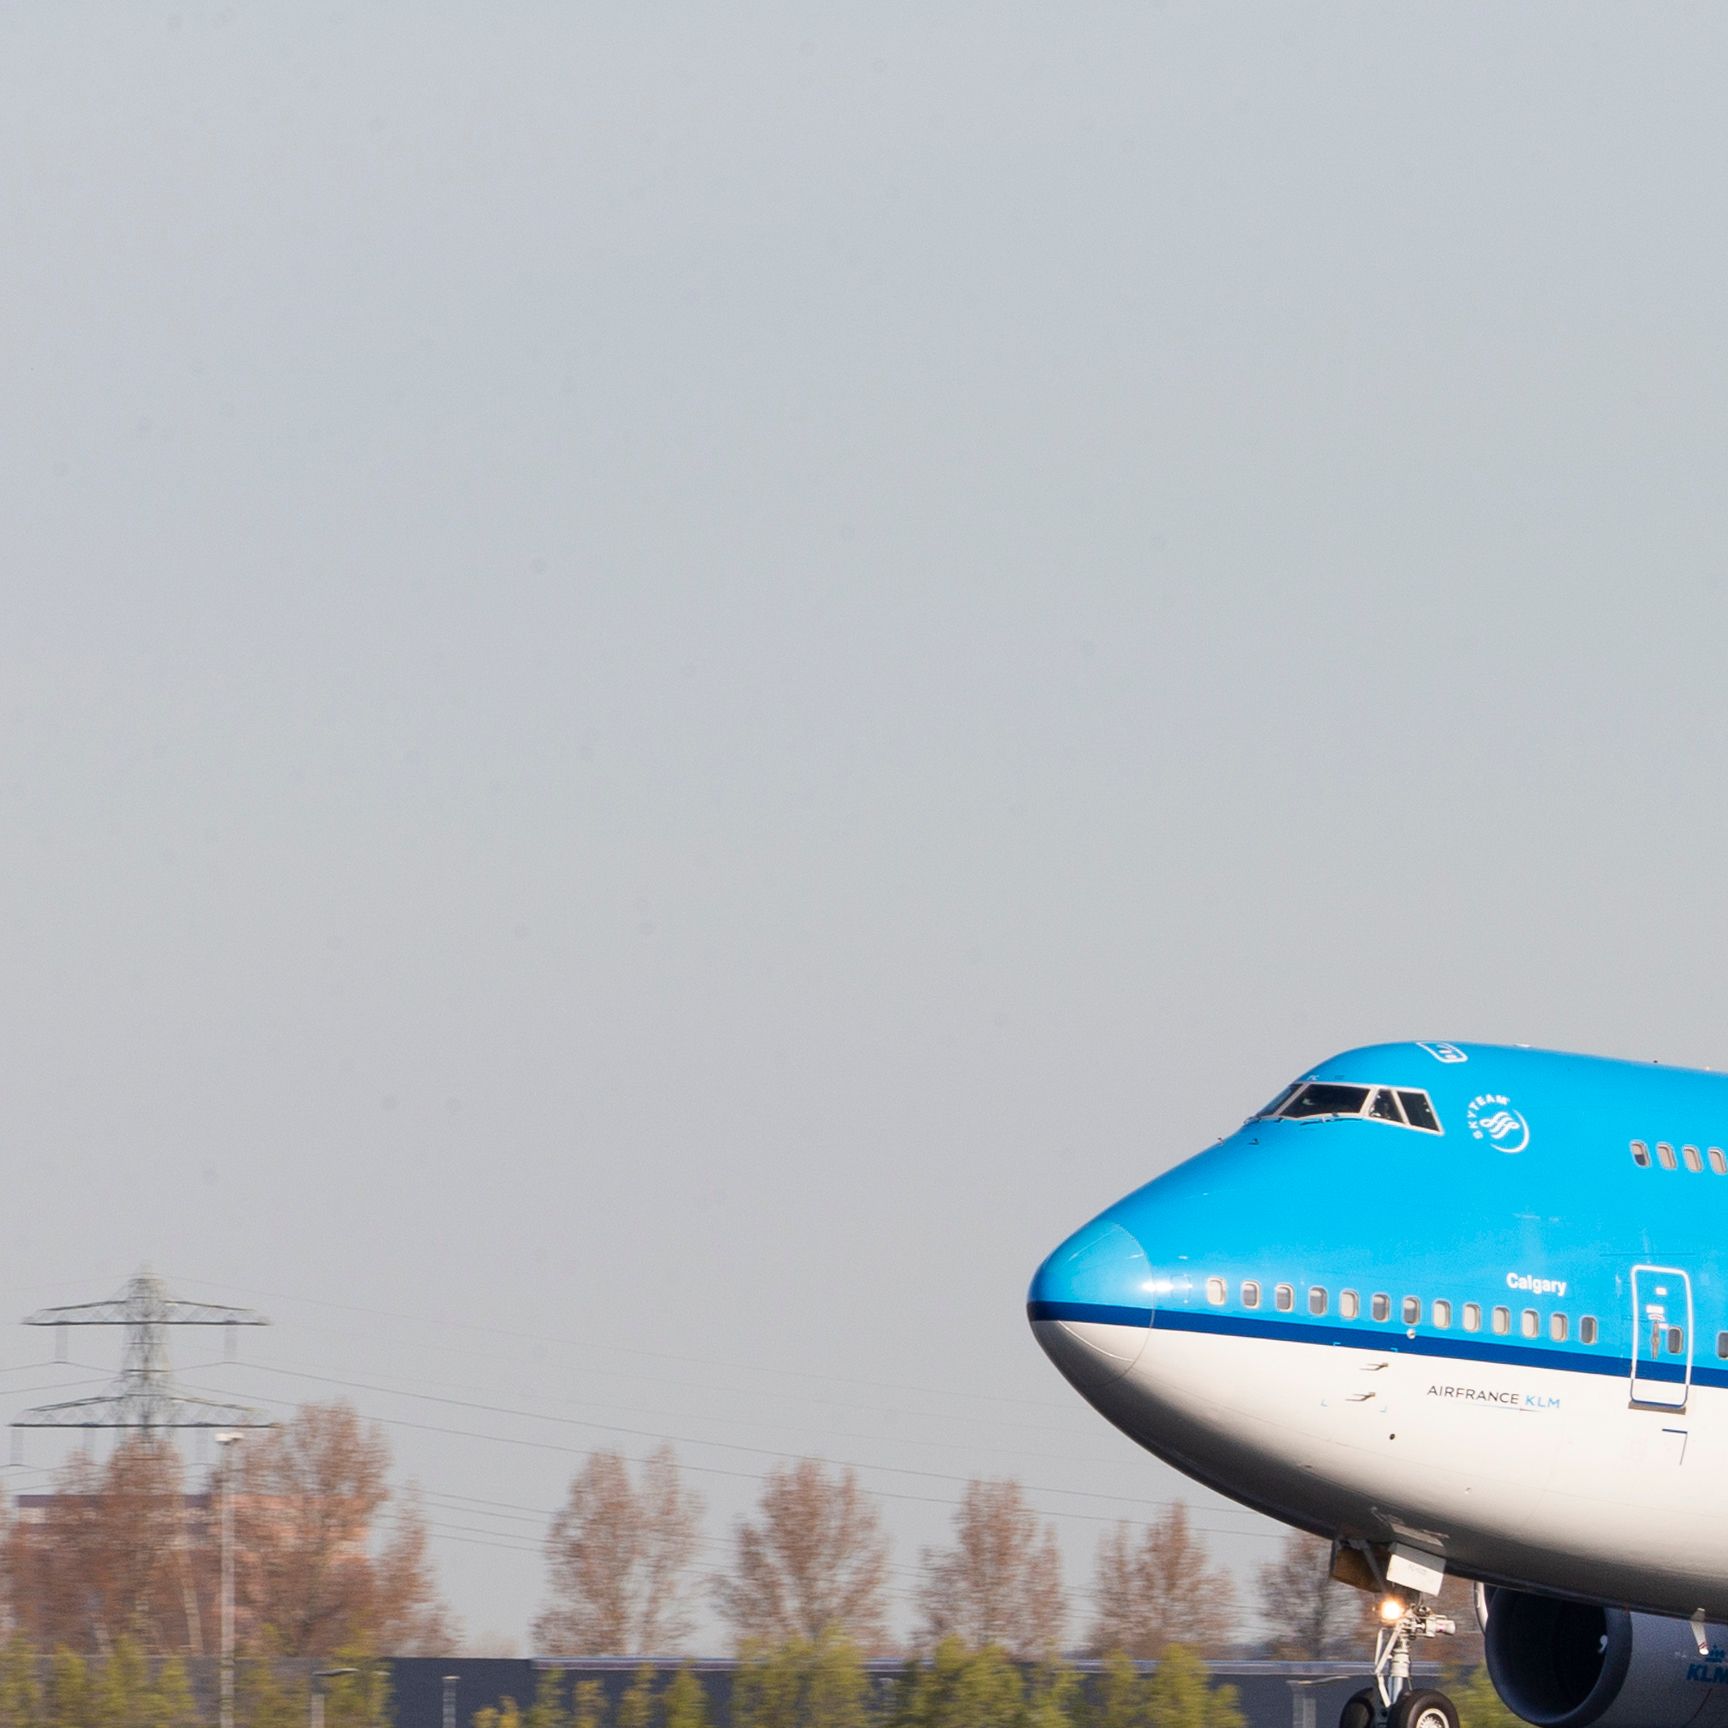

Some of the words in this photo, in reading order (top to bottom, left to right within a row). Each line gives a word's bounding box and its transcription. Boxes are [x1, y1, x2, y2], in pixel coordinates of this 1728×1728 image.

[1467, 1093, 1509, 1140] SKYTEAM
[1505, 1272, 1567, 1297] Calgary
[1524, 1394, 1561, 1409] KLM
